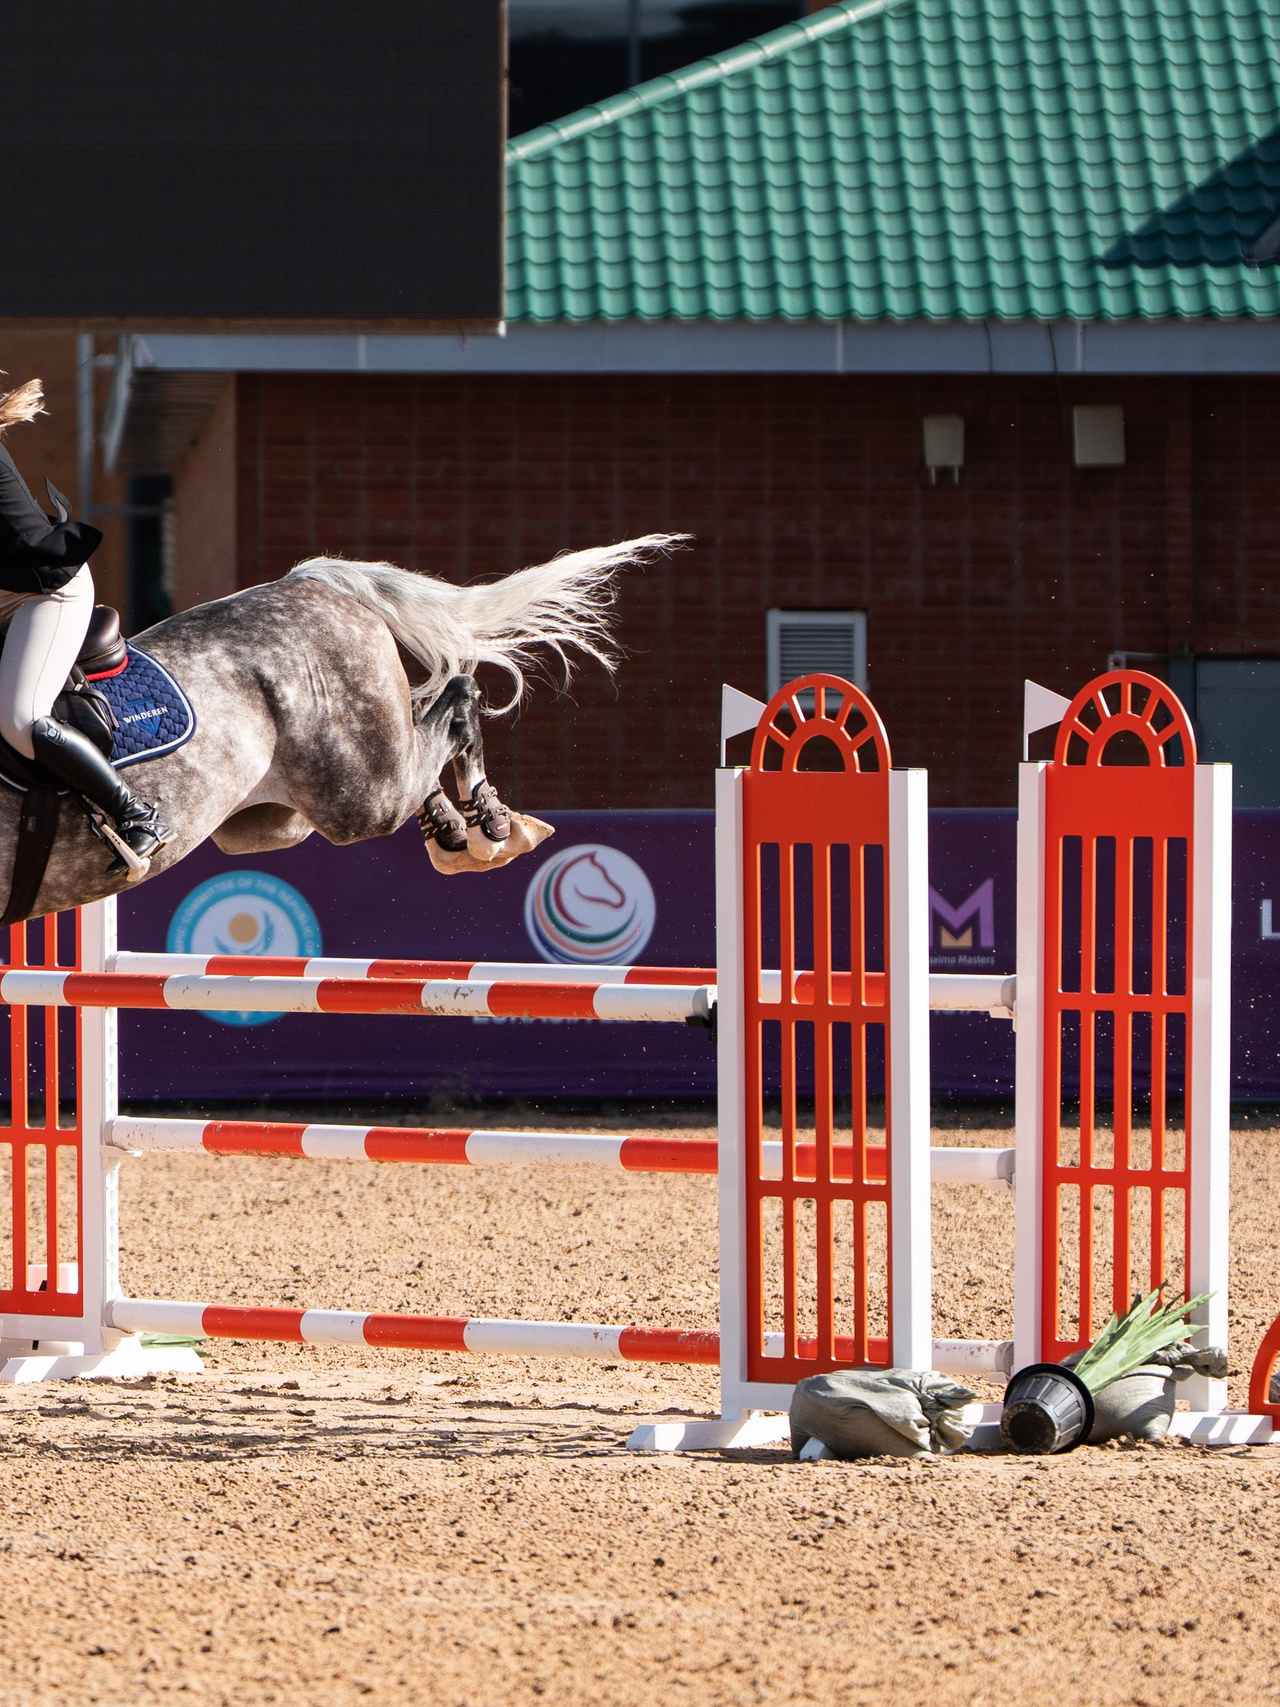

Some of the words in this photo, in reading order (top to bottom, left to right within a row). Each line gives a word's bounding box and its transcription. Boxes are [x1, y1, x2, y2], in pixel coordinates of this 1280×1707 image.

[123, 705, 168, 724] WINDEREN
[929, 955, 956, 965] axima
[958, 954, 995, 966] Masters
